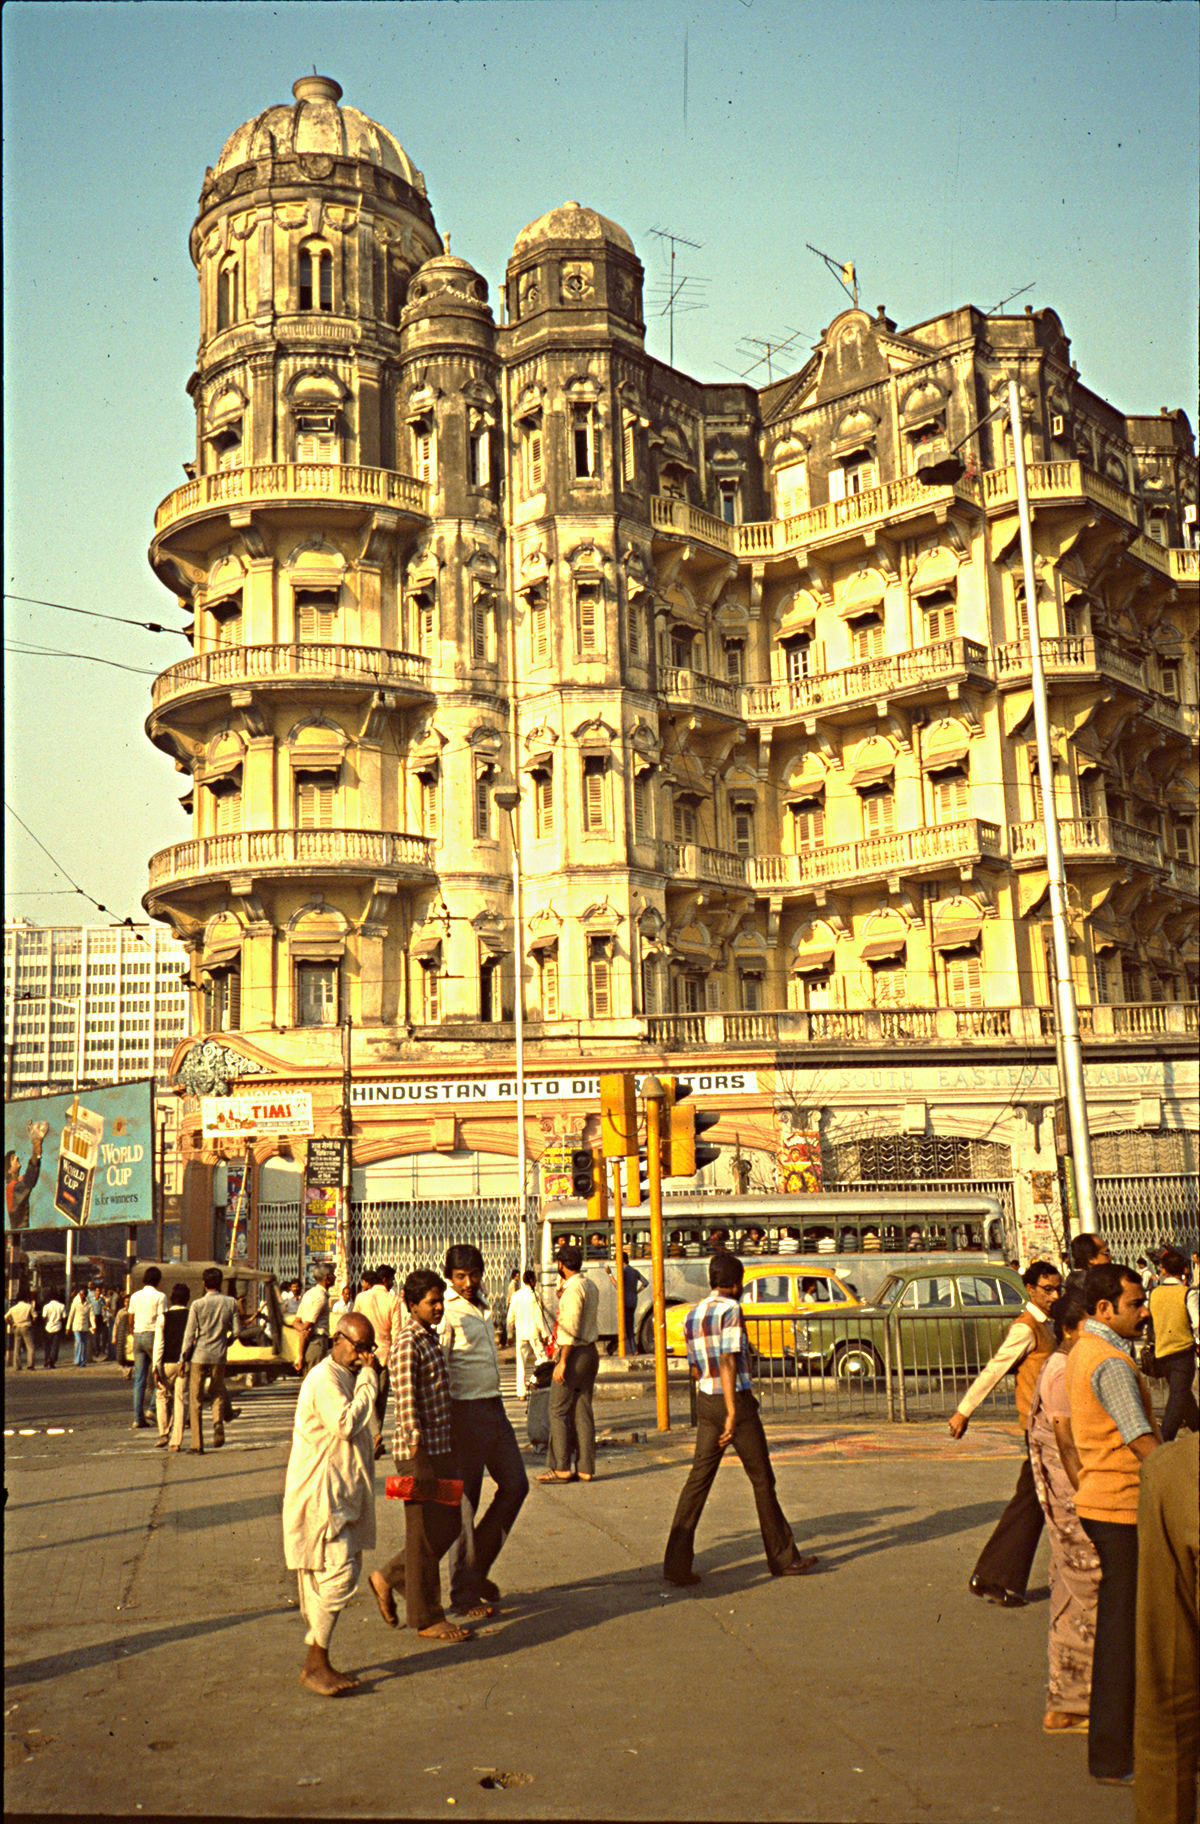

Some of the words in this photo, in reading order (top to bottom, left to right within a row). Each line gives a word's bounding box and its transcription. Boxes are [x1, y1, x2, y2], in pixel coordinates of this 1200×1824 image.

[840, 1071, 914, 1089] SOUTH
[937, 1068, 1053, 1088] EASTERN
[352, 1084, 487, 1102] HINDUSTAN
[498, 1081, 560, 1098] AUTO
[101, 1143, 144, 1165] WORLD
[63, 1159, 86, 1181] WORLD
[106, 1165, 132, 1186] CUP
[64, 1174, 79, 1190] CUP
[110, 1193, 138, 1204] winners
